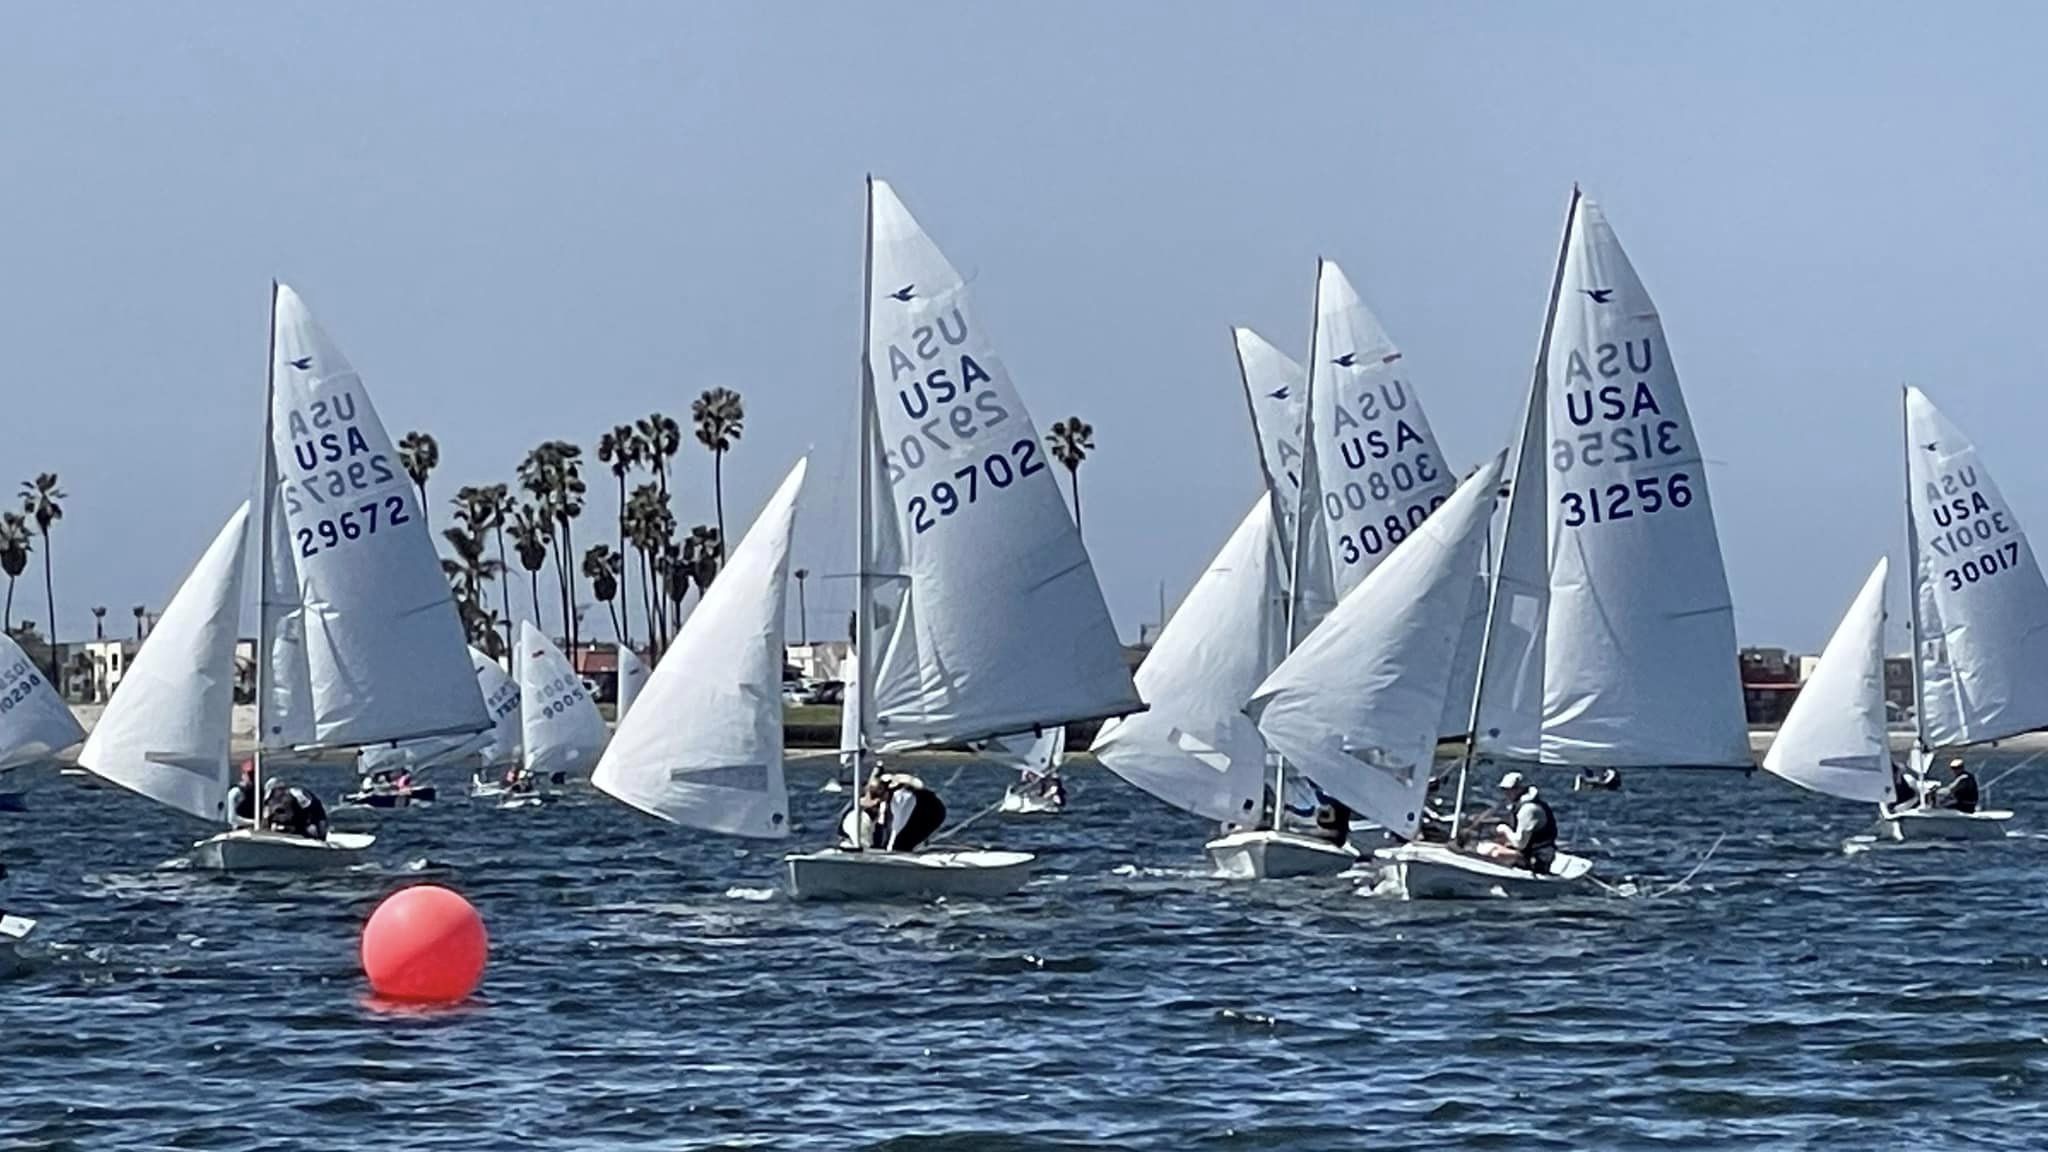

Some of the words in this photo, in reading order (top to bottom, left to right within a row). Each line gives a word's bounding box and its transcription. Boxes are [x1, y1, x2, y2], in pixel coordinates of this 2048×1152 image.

[900, 354, 991, 419] USA
[1567, 381, 1660, 426] USA
[294, 426, 369, 470] USA
[1341, 419, 1424, 469] USA
[908, 439, 1045, 534] 29702
[1560, 472, 1692, 527] 31256
[1933, 491, 1990, 527] USA
[297, 496, 410, 558] 29672
[1944, 541, 2018, 591] 30017
